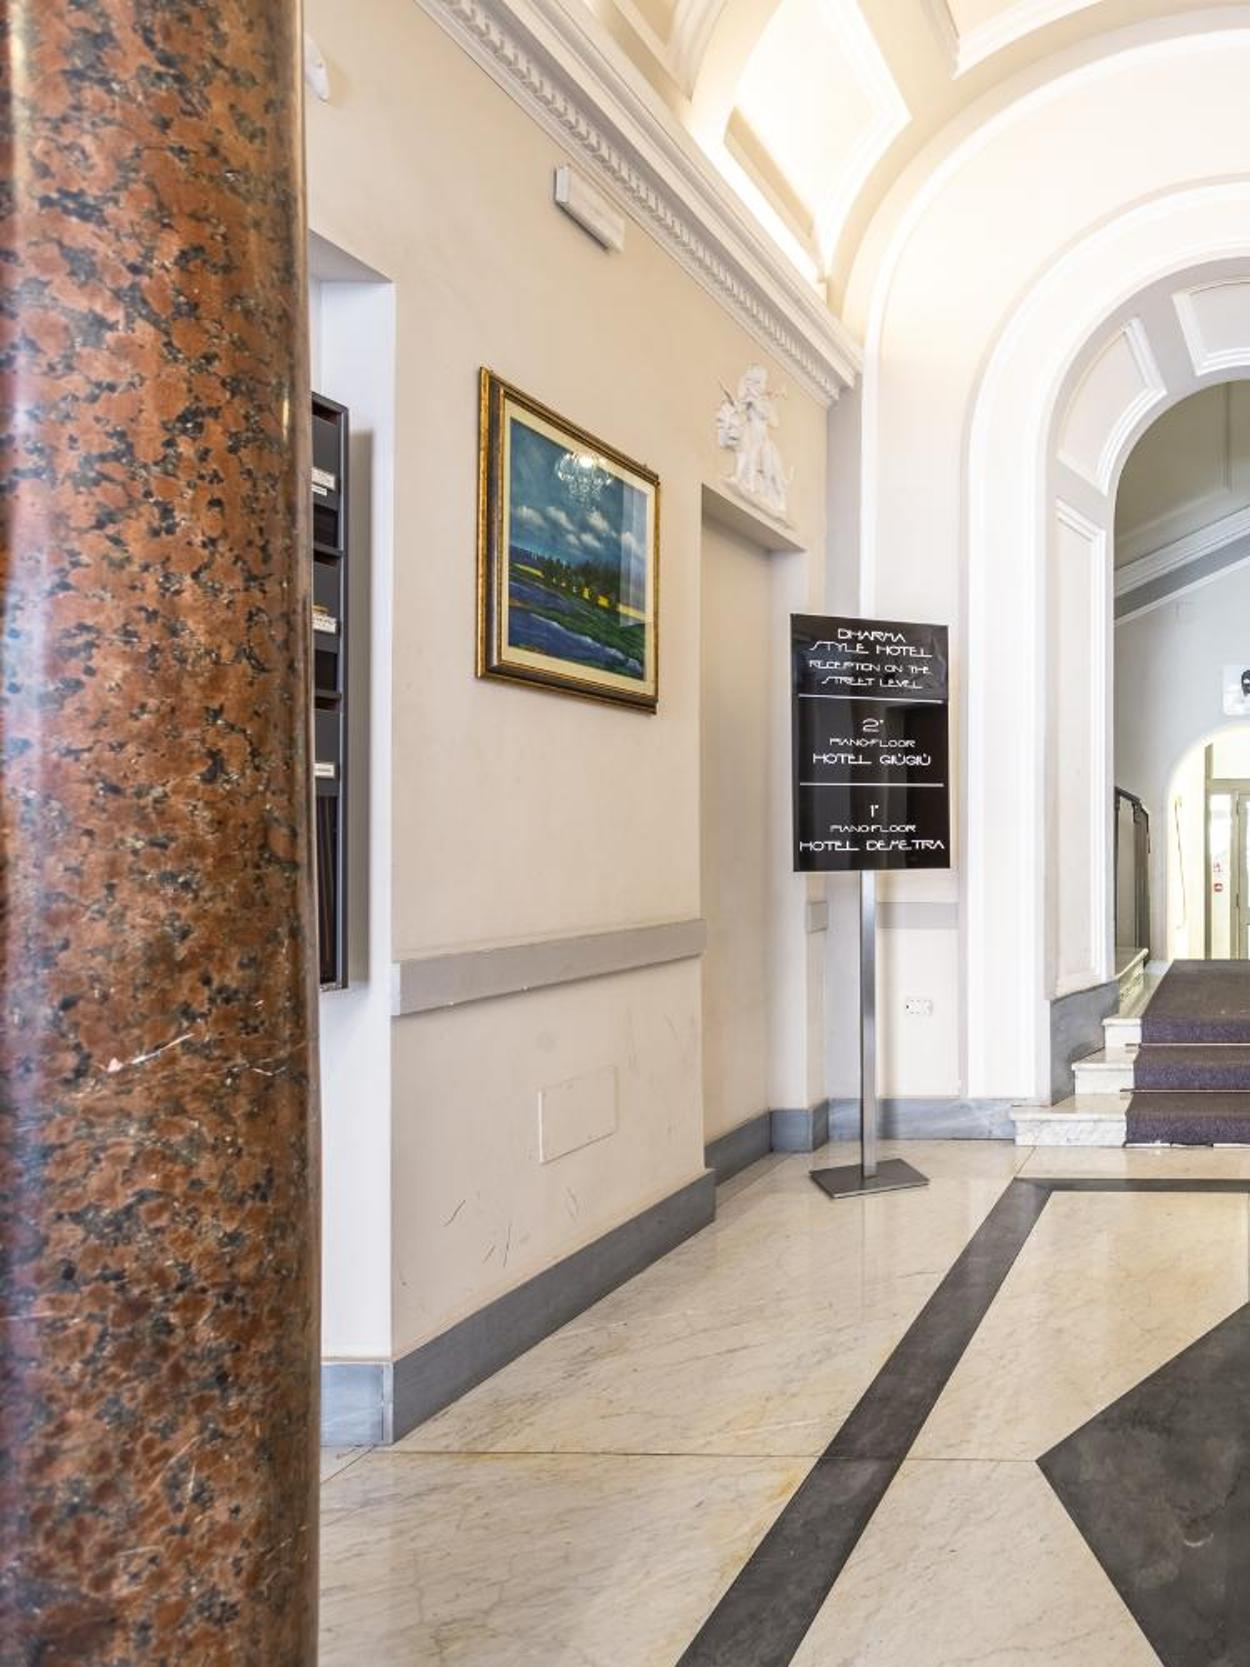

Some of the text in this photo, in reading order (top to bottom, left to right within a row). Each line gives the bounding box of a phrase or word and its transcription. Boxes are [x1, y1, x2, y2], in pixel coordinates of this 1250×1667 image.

[838, 628, 906, 642] DHARMA
[809, 641, 933, 657] STYLE HOTEL
[809, 660, 932, 675] RECEPTION ON THE
[821, 676, 923, 689] STREET LEVEL
[812, 753, 872, 765] HOTEL
[800, 840, 945, 851] HOTEL DEMETRA
